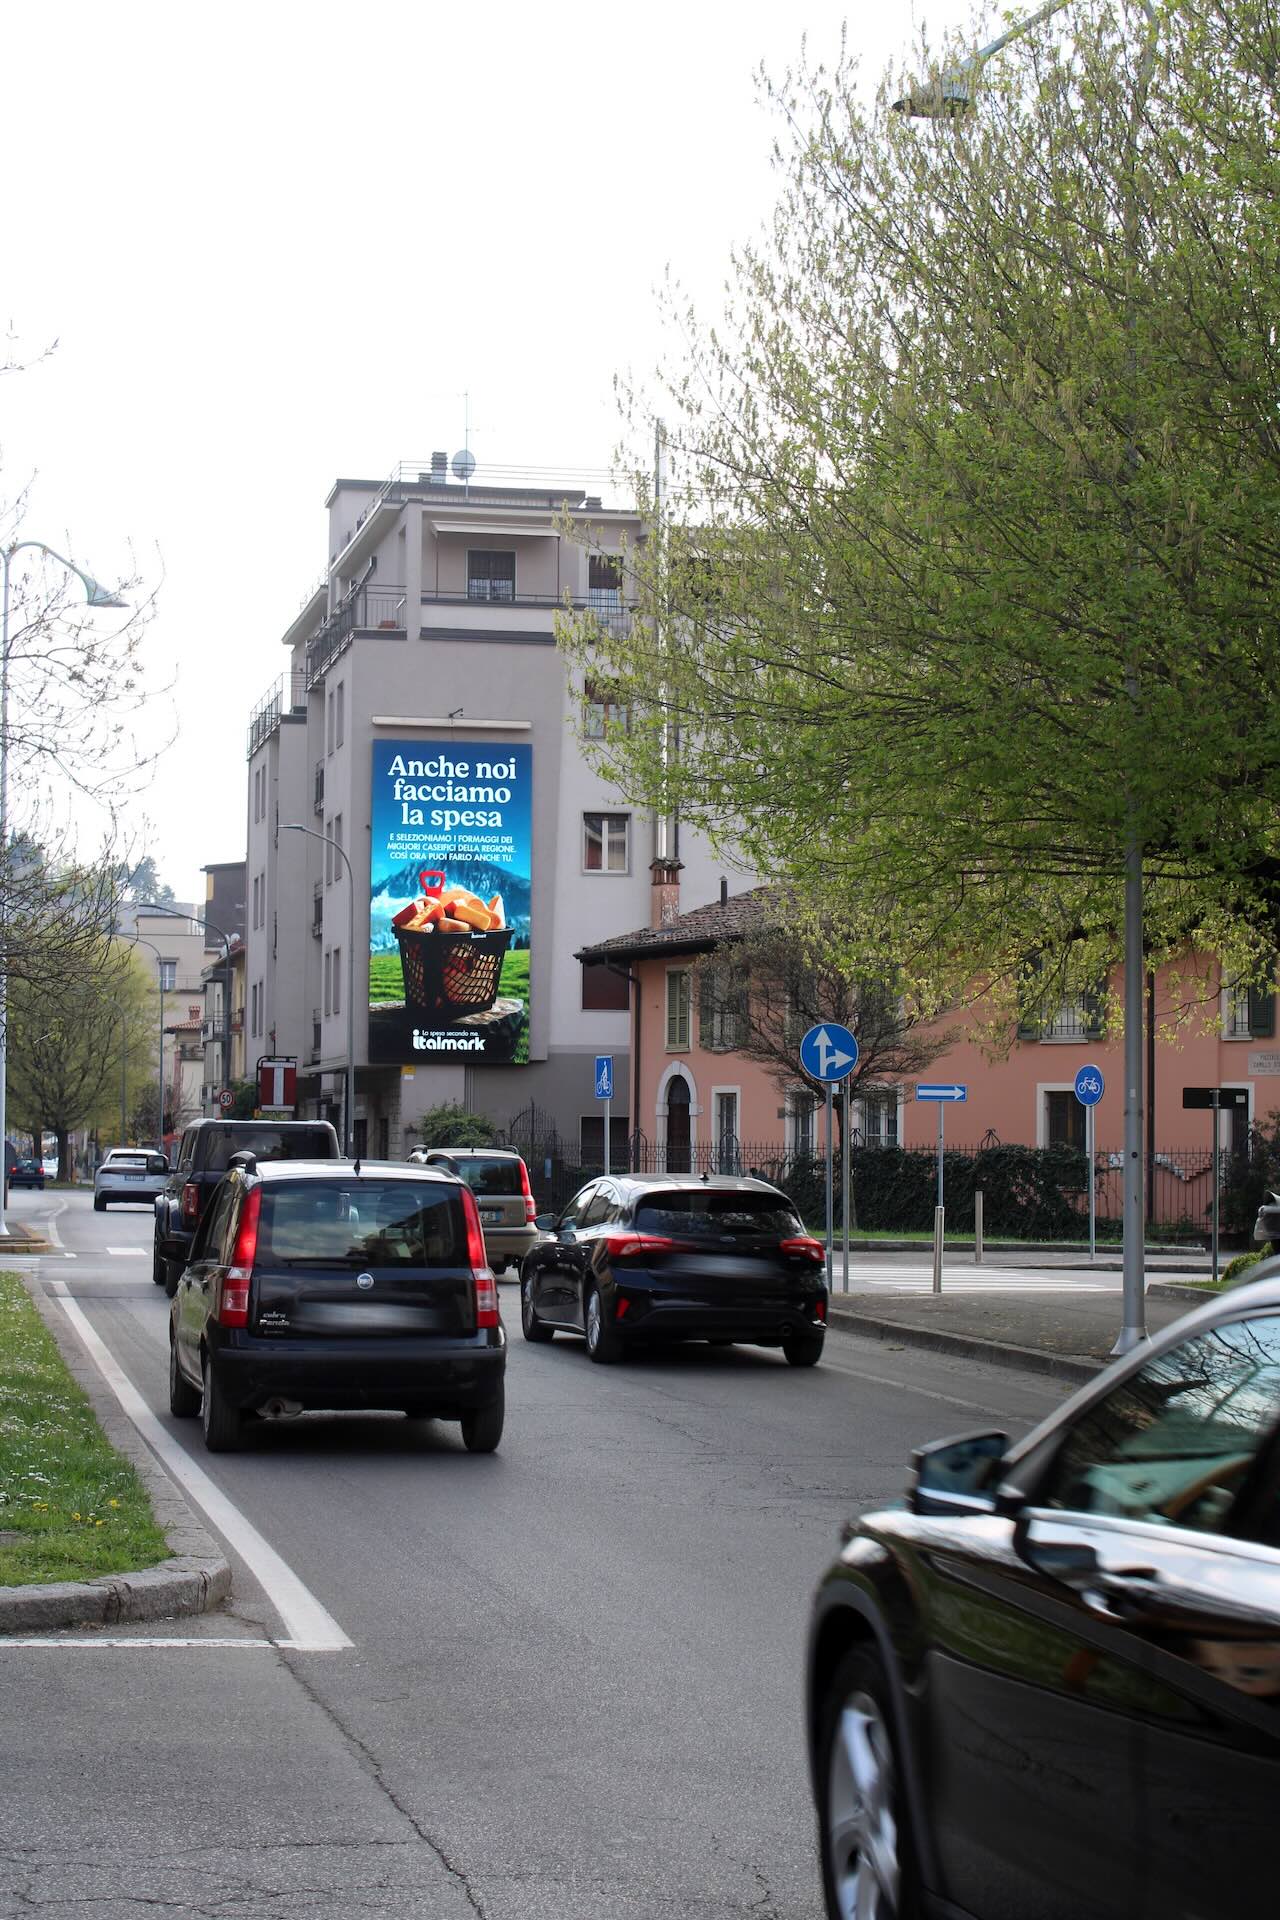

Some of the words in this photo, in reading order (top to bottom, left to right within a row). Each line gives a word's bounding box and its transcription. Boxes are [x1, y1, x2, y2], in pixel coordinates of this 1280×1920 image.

[387, 755, 470, 778] Anche
[475, 757, 517, 779] noi
[393, 778, 512, 804] facciamo
[401, 802, 425, 826] la
[430, 809, 503, 831] spesa
[389, 833, 394, 841] E
[396, 833, 452, 842] SELEZIONIAMO
[458, 835, 499, 844] FORMAGGI
[501, 836, 513, 844] DEI
[386, 842, 420, 850] MIGLIORI
[422, 843, 456, 852] CASEIFICI
[458, 844, 480, 852] DELLA
[481, 845, 517, 853] REGIONE.
[390, 850, 408, 859] COSÌ
[409, 852, 426, 860] ORA
[449, 853, 472, 861] FARLO
[502, 854, 513, 862] TU.
[412, 1029, 486, 1050] italmark
[222, 1094, 231, 1104] 50
